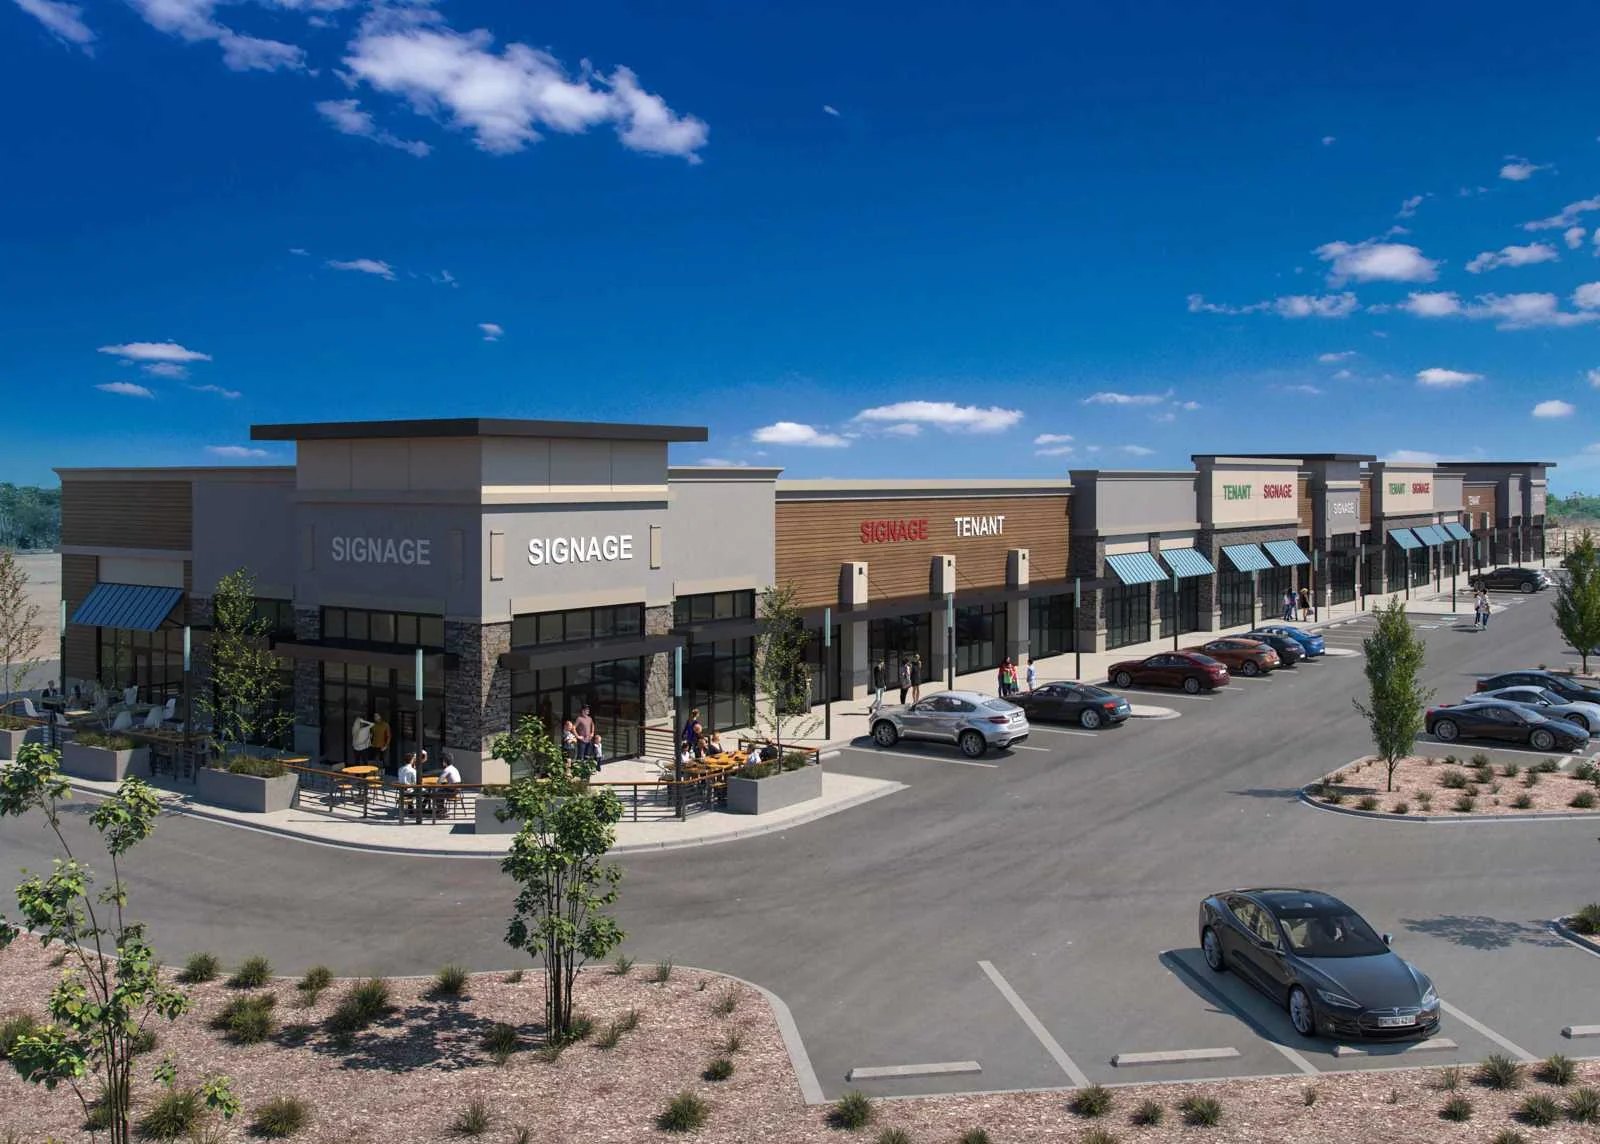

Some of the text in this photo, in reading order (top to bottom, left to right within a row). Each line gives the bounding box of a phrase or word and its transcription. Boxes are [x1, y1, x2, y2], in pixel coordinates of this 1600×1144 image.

[1223, 484, 1292, 500] TENANT SIGNAGE
[1333, 502, 1355, 514] SIGNAGE
[860, 519, 928, 544] SIGNAGE
[954, 515, 1005, 536] TENANT
[331, 536, 431, 565] SIGNAGE
[528, 535, 633, 565] SIGNAGE
